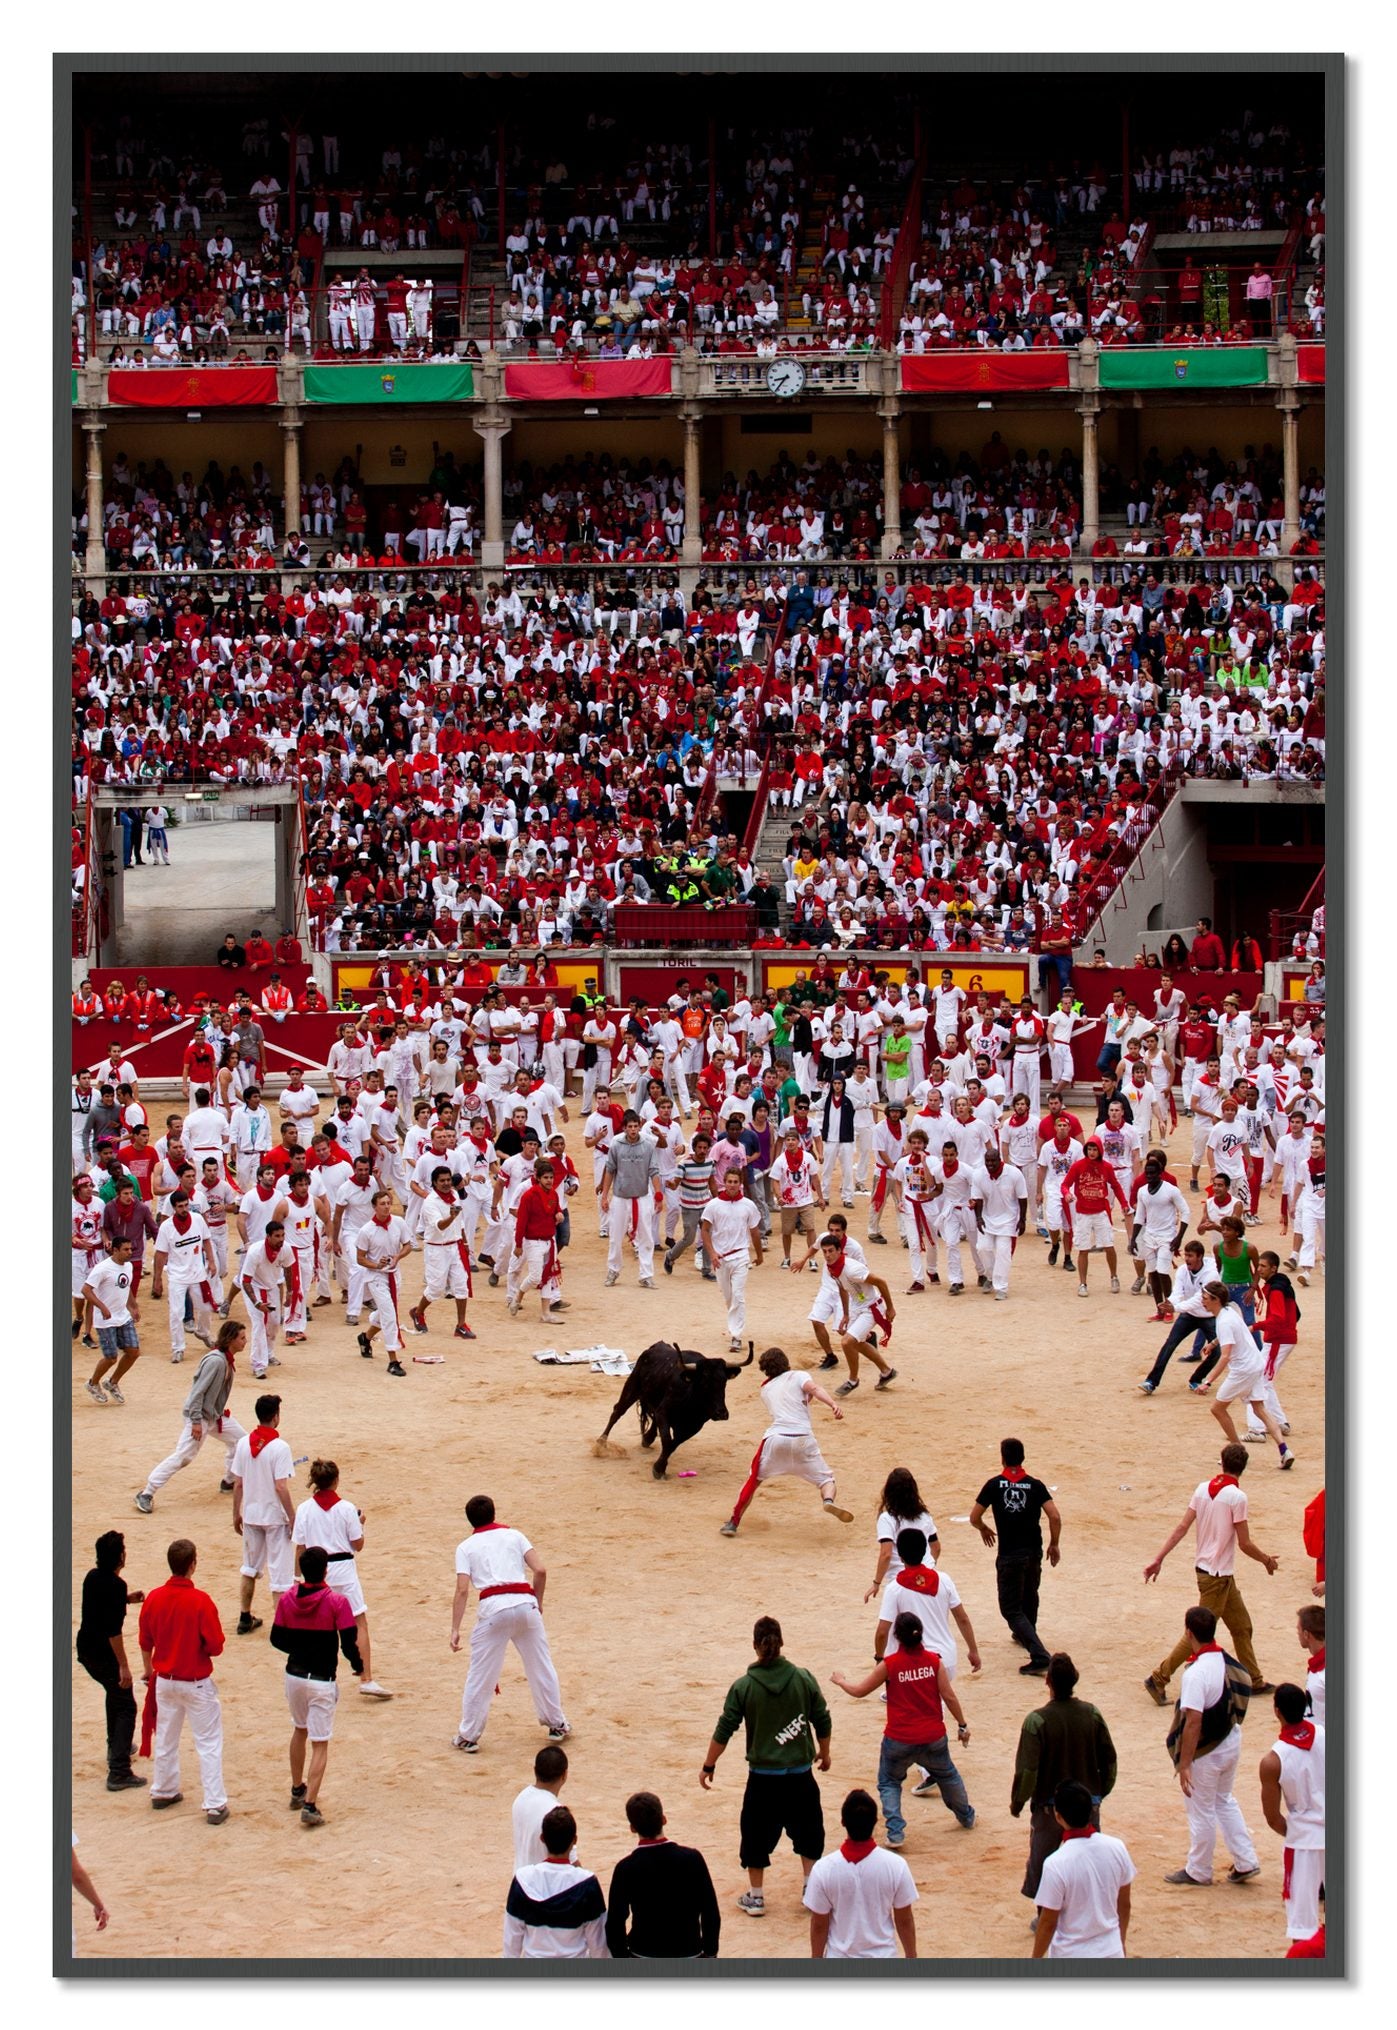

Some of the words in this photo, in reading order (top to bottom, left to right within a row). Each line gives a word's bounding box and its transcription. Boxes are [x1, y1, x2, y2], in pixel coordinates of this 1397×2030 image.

[661, 958, 697, 967] TORIL
[969, 974, 984, 991] 6
[898, 1666, 935, 1683] GALLEGA
